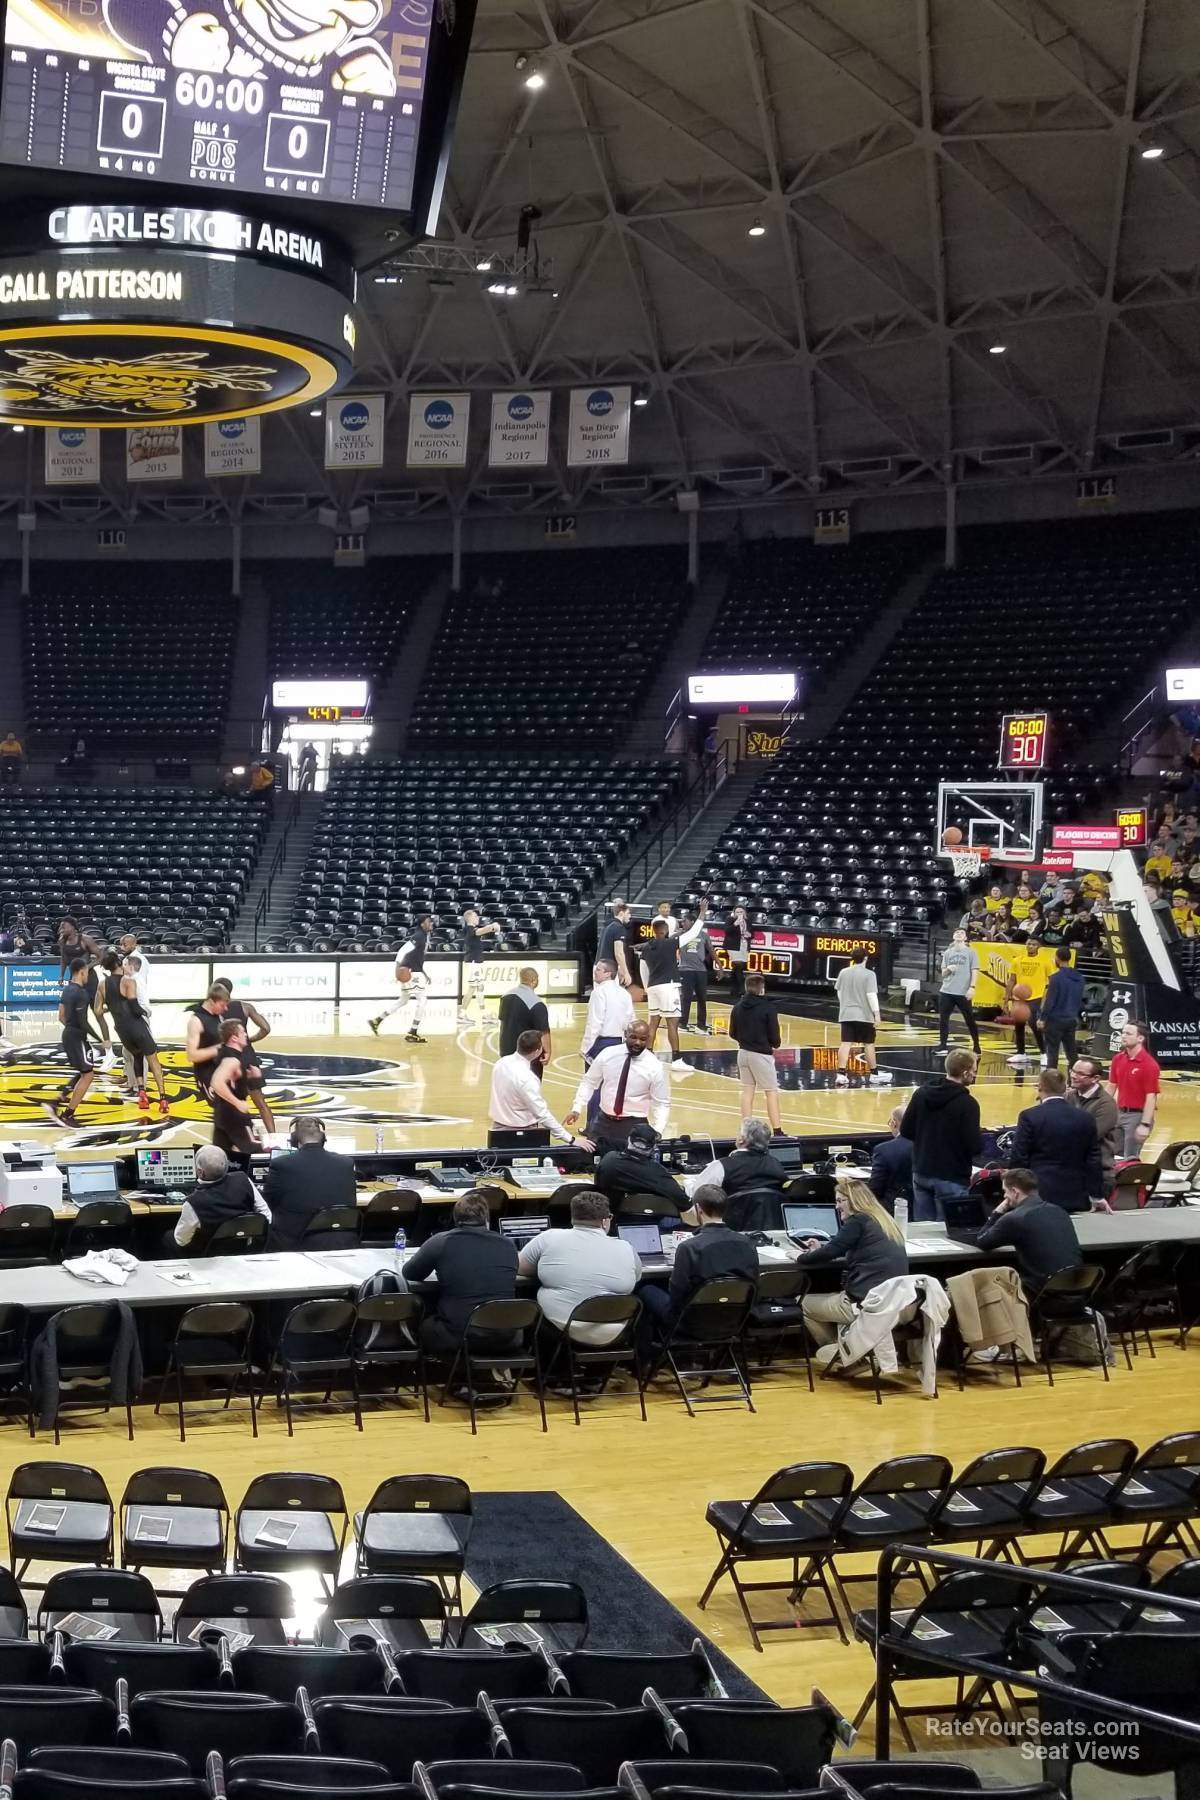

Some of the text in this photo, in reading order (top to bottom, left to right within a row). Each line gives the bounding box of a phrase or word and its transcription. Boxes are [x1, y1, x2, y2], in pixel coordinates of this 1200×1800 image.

[175, 72, 263, 114] 60:00
[122, 104, 143, 138] 0
[222, 124, 230, 138] 1
[288, 125, 308, 159] 0
[191, 139, 236, 168] POS
[114, 156, 124, 171] 4
[257, 223, 323, 268] ARENA
[56, 269, 182, 300] PATTERSON
[510, 407, 534, 415] NCAA
[589, 402, 613, 411] NCAA
[343, 415, 368, 425] NCAA
[427, 414, 453, 423] NCAA
[220, 423, 246, 433] NCAA
[495, 421, 546, 431] Indianapolis
[61, 432, 85, 442] NCAA
[502, 432, 538, 442] Regional
[582, 433, 616, 441] Regional
[414, 440, 461, 448] REGIONAL
[211, 448, 255, 457] REGIONAL
[342, 451, 365, 461] 2015
[424, 450, 448, 459] 2016
[505, 451, 531, 460] 2017
[586, 448, 610, 459] 2018
[50, 456, 94, 465] REGIONAL
[221, 459, 243, 468] 2014
[61, 467, 83, 476] 2012
[145, 463, 167, 473] 2013
[1079, 478, 1114, 497] 114
[816, 509, 848, 528] 113
[546, 516, 576, 532] 112
[98, 530, 125, 545] 110
[336, 535, 364, 550] 111
[308, 706, 339, 720] 4:47
[1009, 720, 1043, 736] 60:00
[1012, 737, 1038, 762] 30
[1123, 826, 1138, 840] 30
[1102, 912, 1129, 977] WSU
[12, 980, 43, 988] employee
[261, 975, 327, 985] HUTTON
[1149, 1021, 1196, 1033] KANSAS
